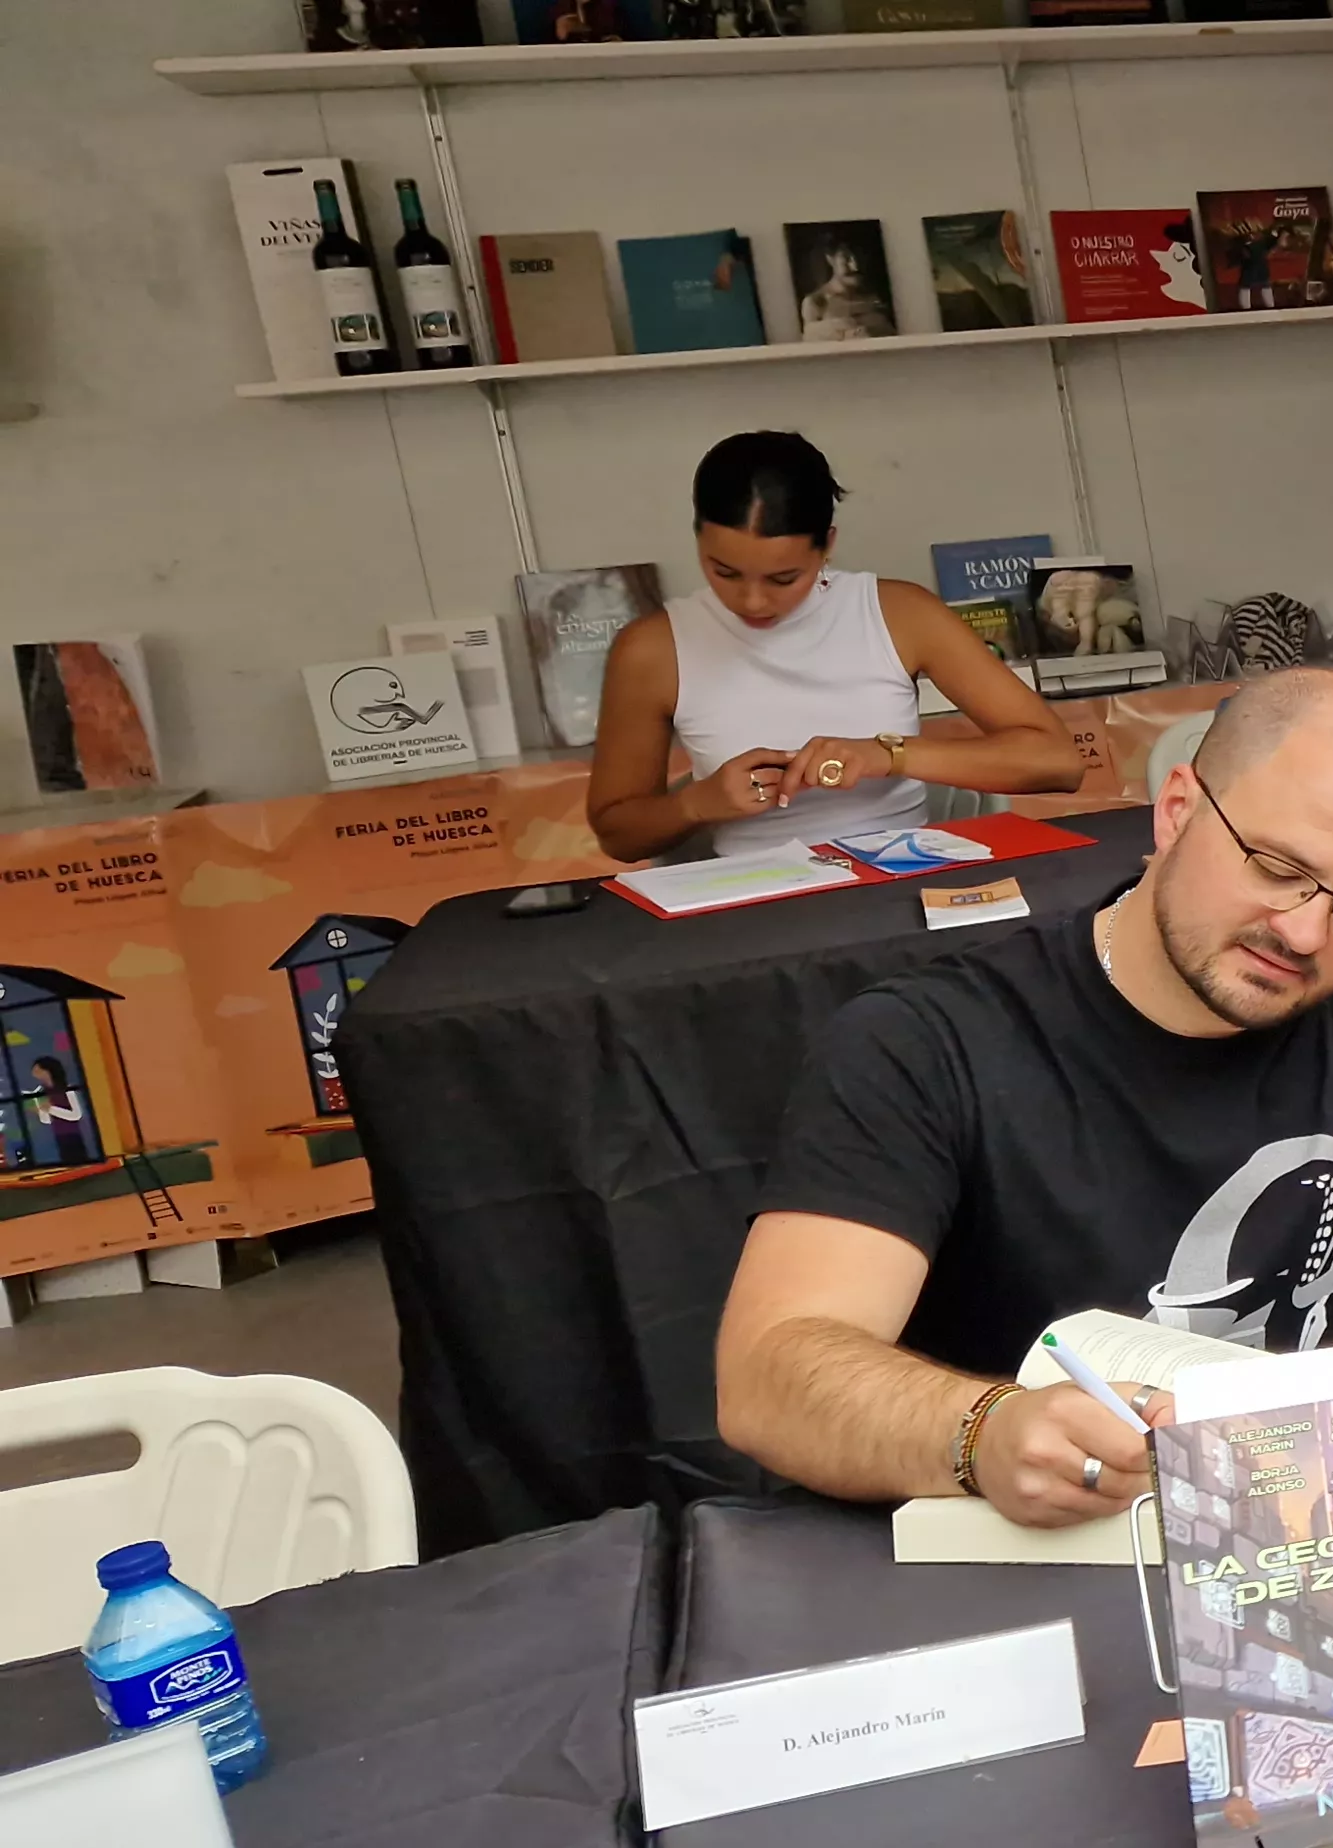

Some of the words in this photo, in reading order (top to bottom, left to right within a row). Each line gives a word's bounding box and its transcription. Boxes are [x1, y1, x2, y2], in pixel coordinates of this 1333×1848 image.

[1273, 204, 1310, 220] Goya
[964, 555, 1031, 576] RAMÓN
[398, 734, 461, 748] PROVINCIAL
[333, 758, 347, 767] DE
[408, 748, 422, 757] DE
[425, 743, 467, 754] HUESCA
[335, 821, 388, 839] FERIA
[396, 816, 429, 829] DEL
[435, 807, 488, 824] LIBRO
[392, 833, 416, 847] DE
[423, 824, 493, 843] HUESCA
[0, 868, 50, 884] ERIA
[58, 861, 94, 876] DEL
[101, 852, 158, 870] LIBRO
[55, 880, 80, 893] DE
[87, 870, 163, 889] HUESCA
[1228, 1421, 1313, 1444] ALEJANDRO
[1250, 1440, 1295, 1456] MARIN
[1251, 1465, 1300, 1482] BORJA
[1247, 1479, 1306, 1497] ALONSO
[1182, 1554, 1247, 1587] LA
[1234, 1573, 1299, 1607] DE
[170, 1658, 212, 1680] MONTE
[176, 1666, 213, 1685] PINOS
[783, 1738, 802, 1751] D.
[807, 1721, 890, 1747] Alejandro
[895, 1707, 946, 1729] Marín
